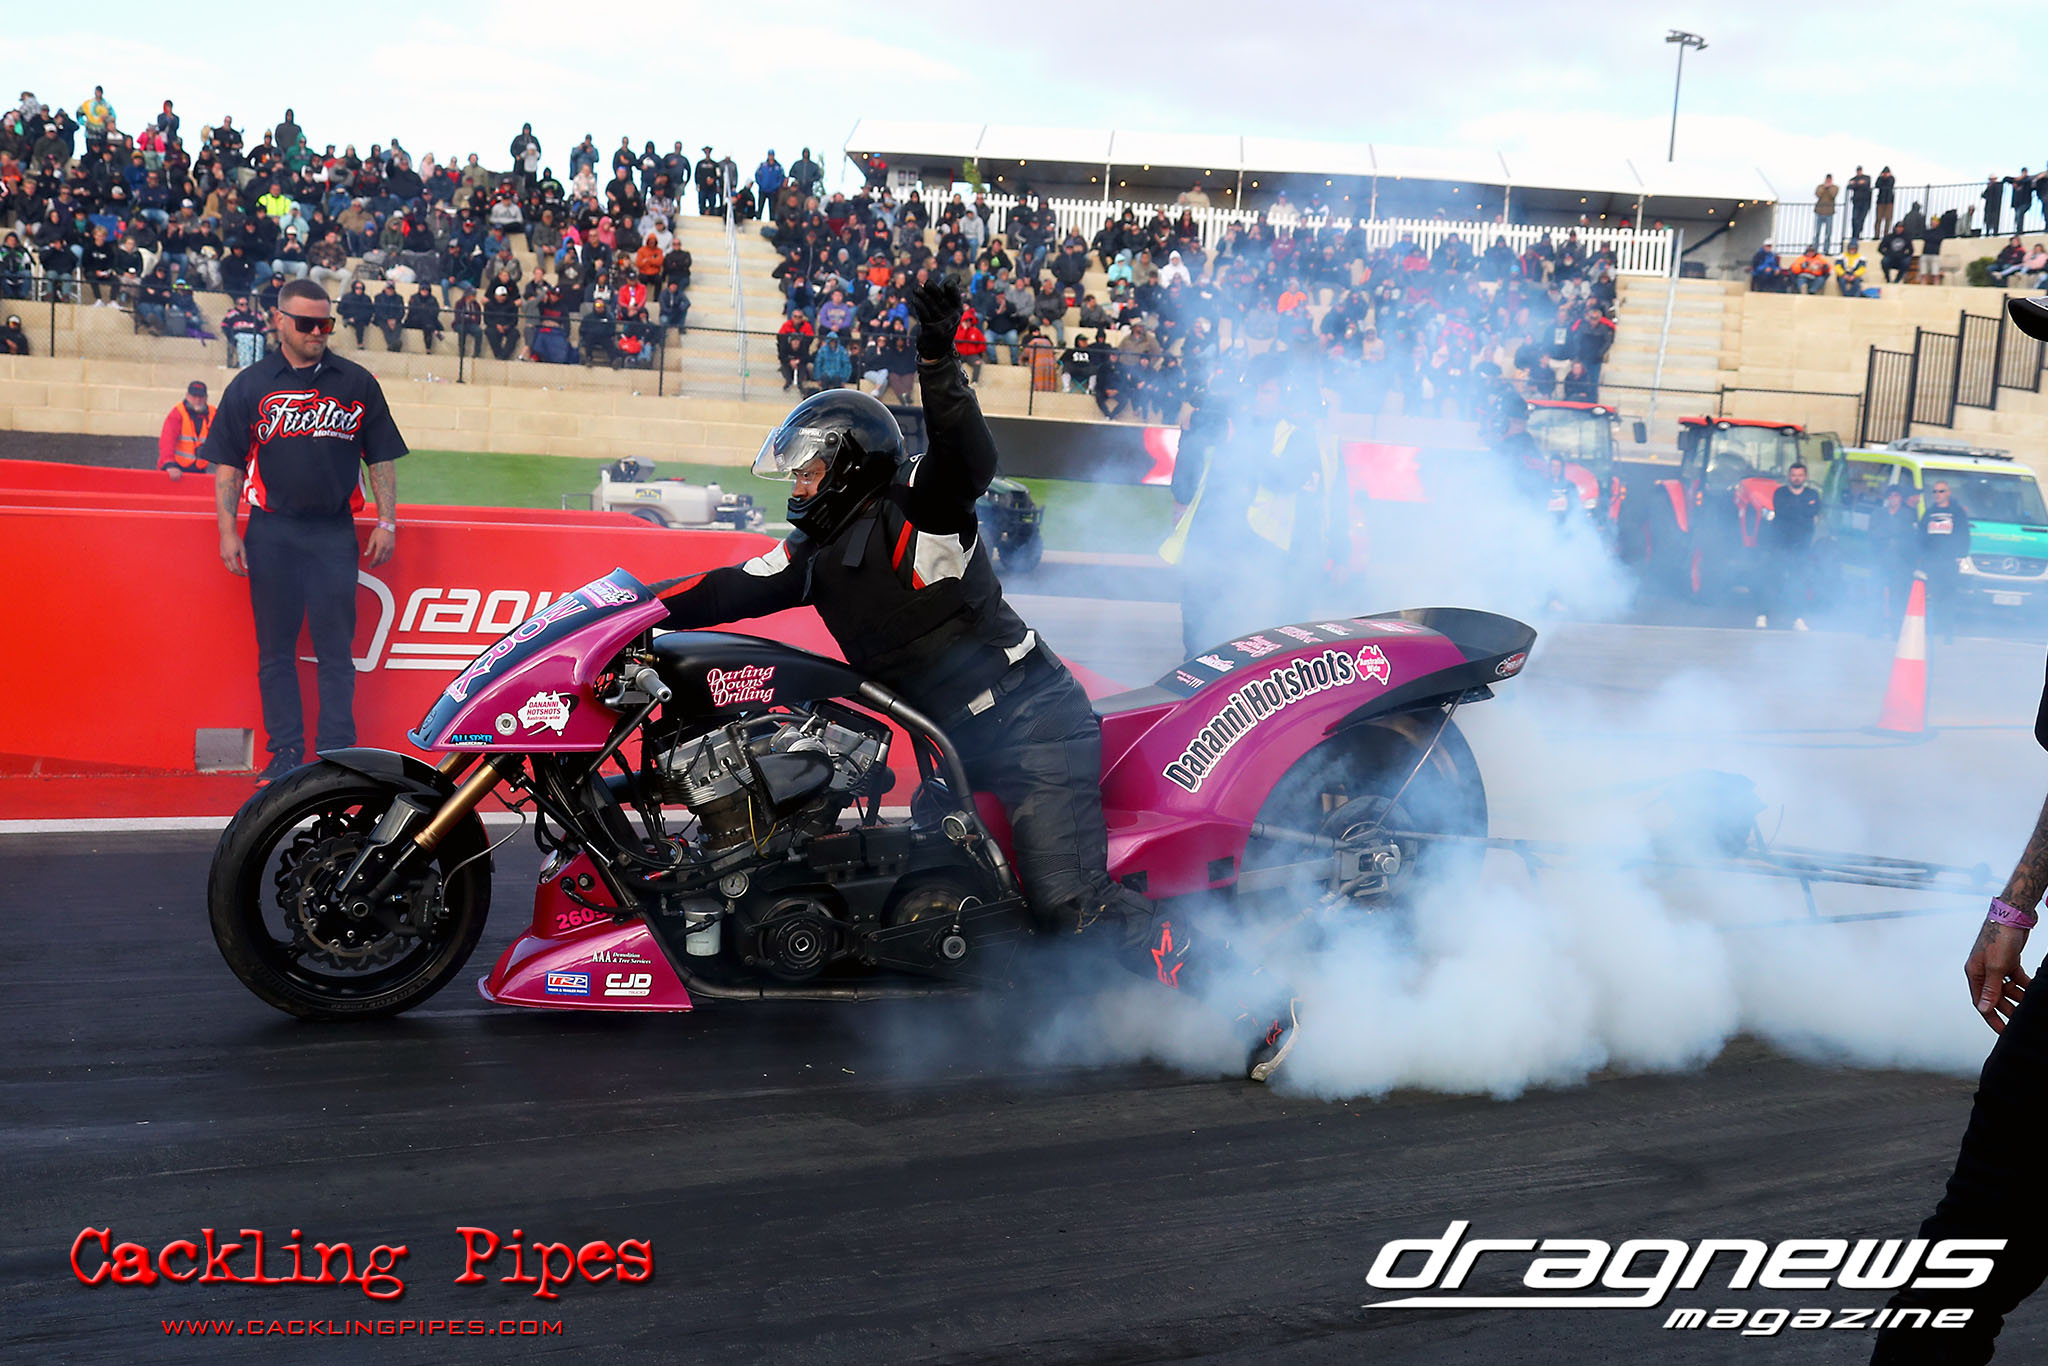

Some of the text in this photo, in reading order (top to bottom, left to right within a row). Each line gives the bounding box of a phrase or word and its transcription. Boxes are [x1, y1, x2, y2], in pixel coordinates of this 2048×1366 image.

[257, 392, 364, 441] Fuelled
[1360, 656, 1385, 666] Australia
[707, 664, 776, 686] Darling
[710, 678, 764, 696] Downs
[713, 686, 776, 706] Drilling
[526, 708, 561, 716] HOTSHOTS
[1164, 649, 1354, 791] Dananni Hotshots
[592, 950, 612, 963] AAA
[605, 973, 653, 988] CJD
